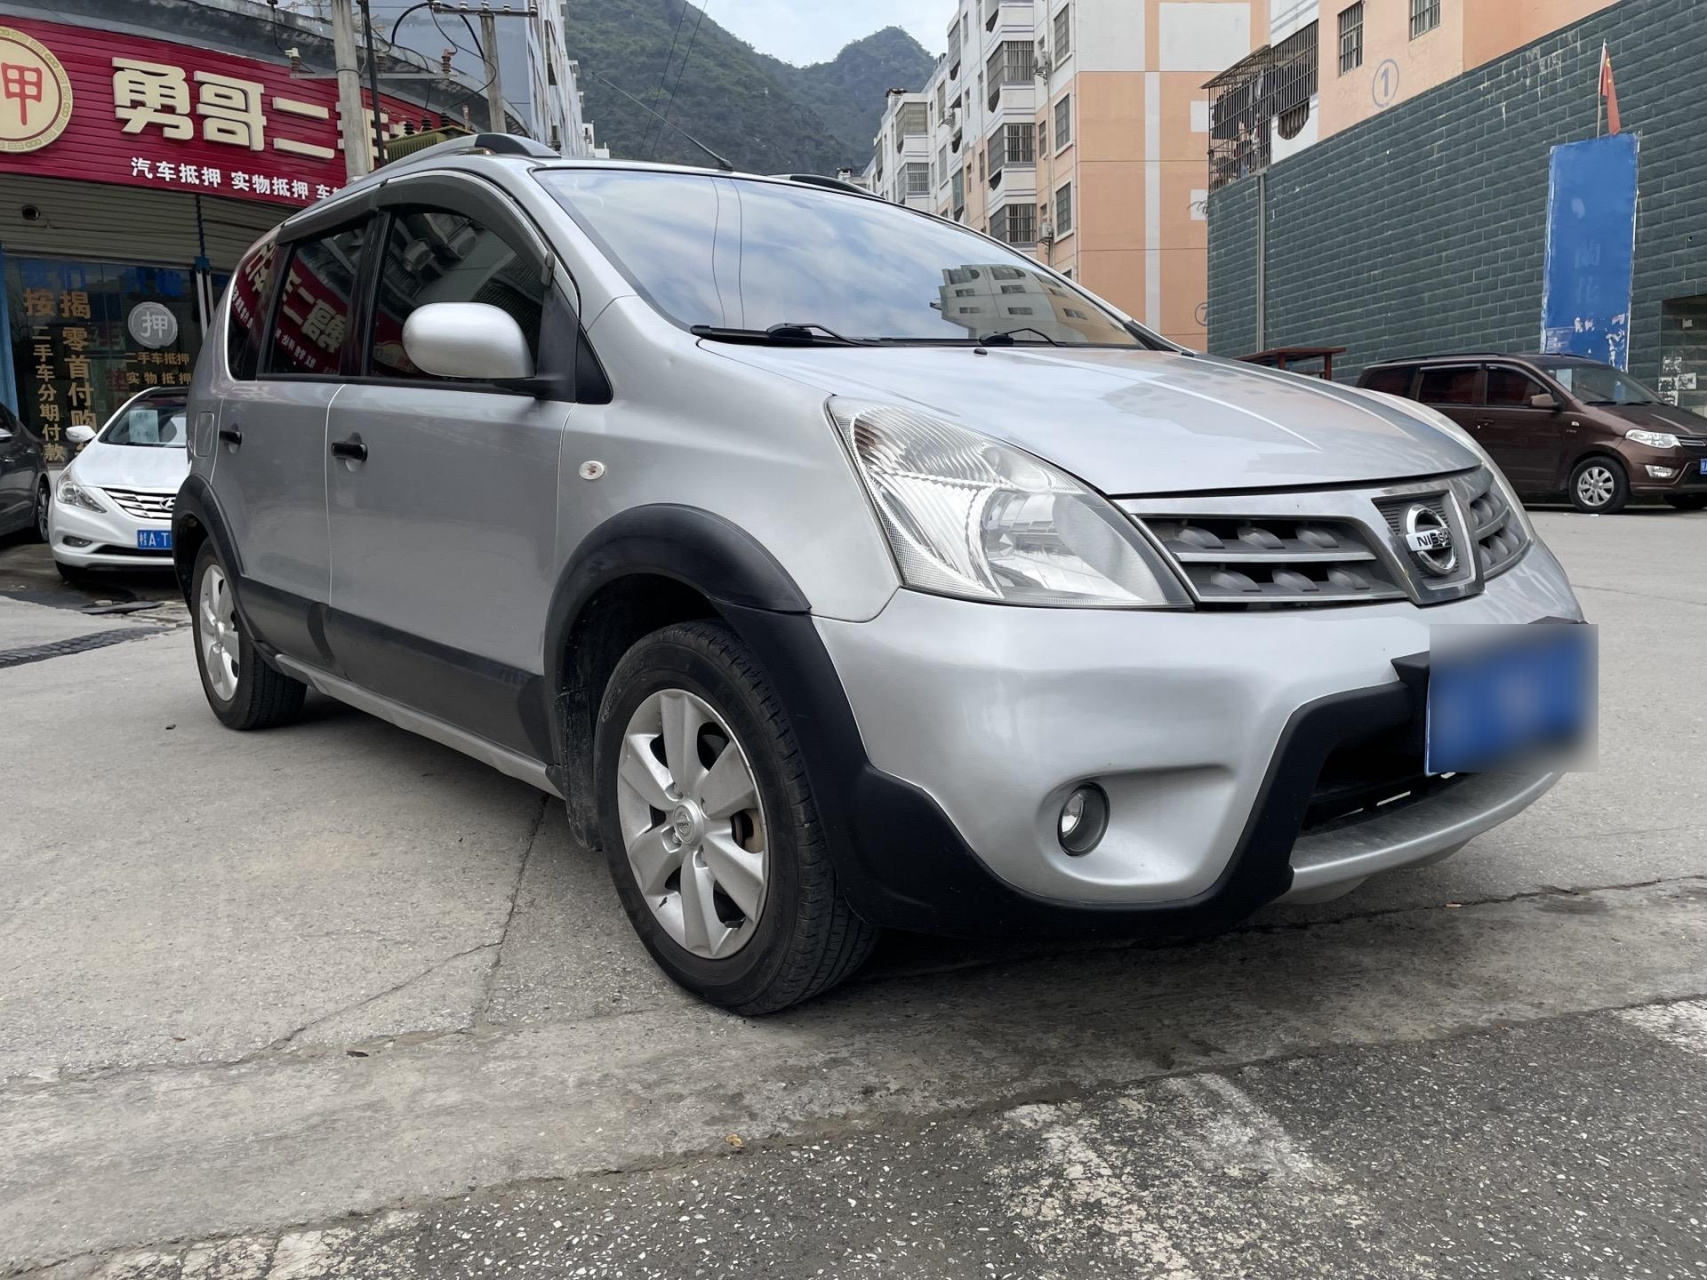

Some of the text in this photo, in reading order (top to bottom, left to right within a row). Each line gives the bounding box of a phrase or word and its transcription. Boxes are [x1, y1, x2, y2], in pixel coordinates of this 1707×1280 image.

[131, 157, 222, 188] 汽车抵押
[231, 171, 309, 200] 实物抵押
[23, 288, 91, 319] 按揭
[140, 311, 168, 339] 押
[125, 351, 190, 365] 二手车抵押
[32, 326, 65, 461] 二手车分期付款
[62, 327, 98, 456] 零首付购
